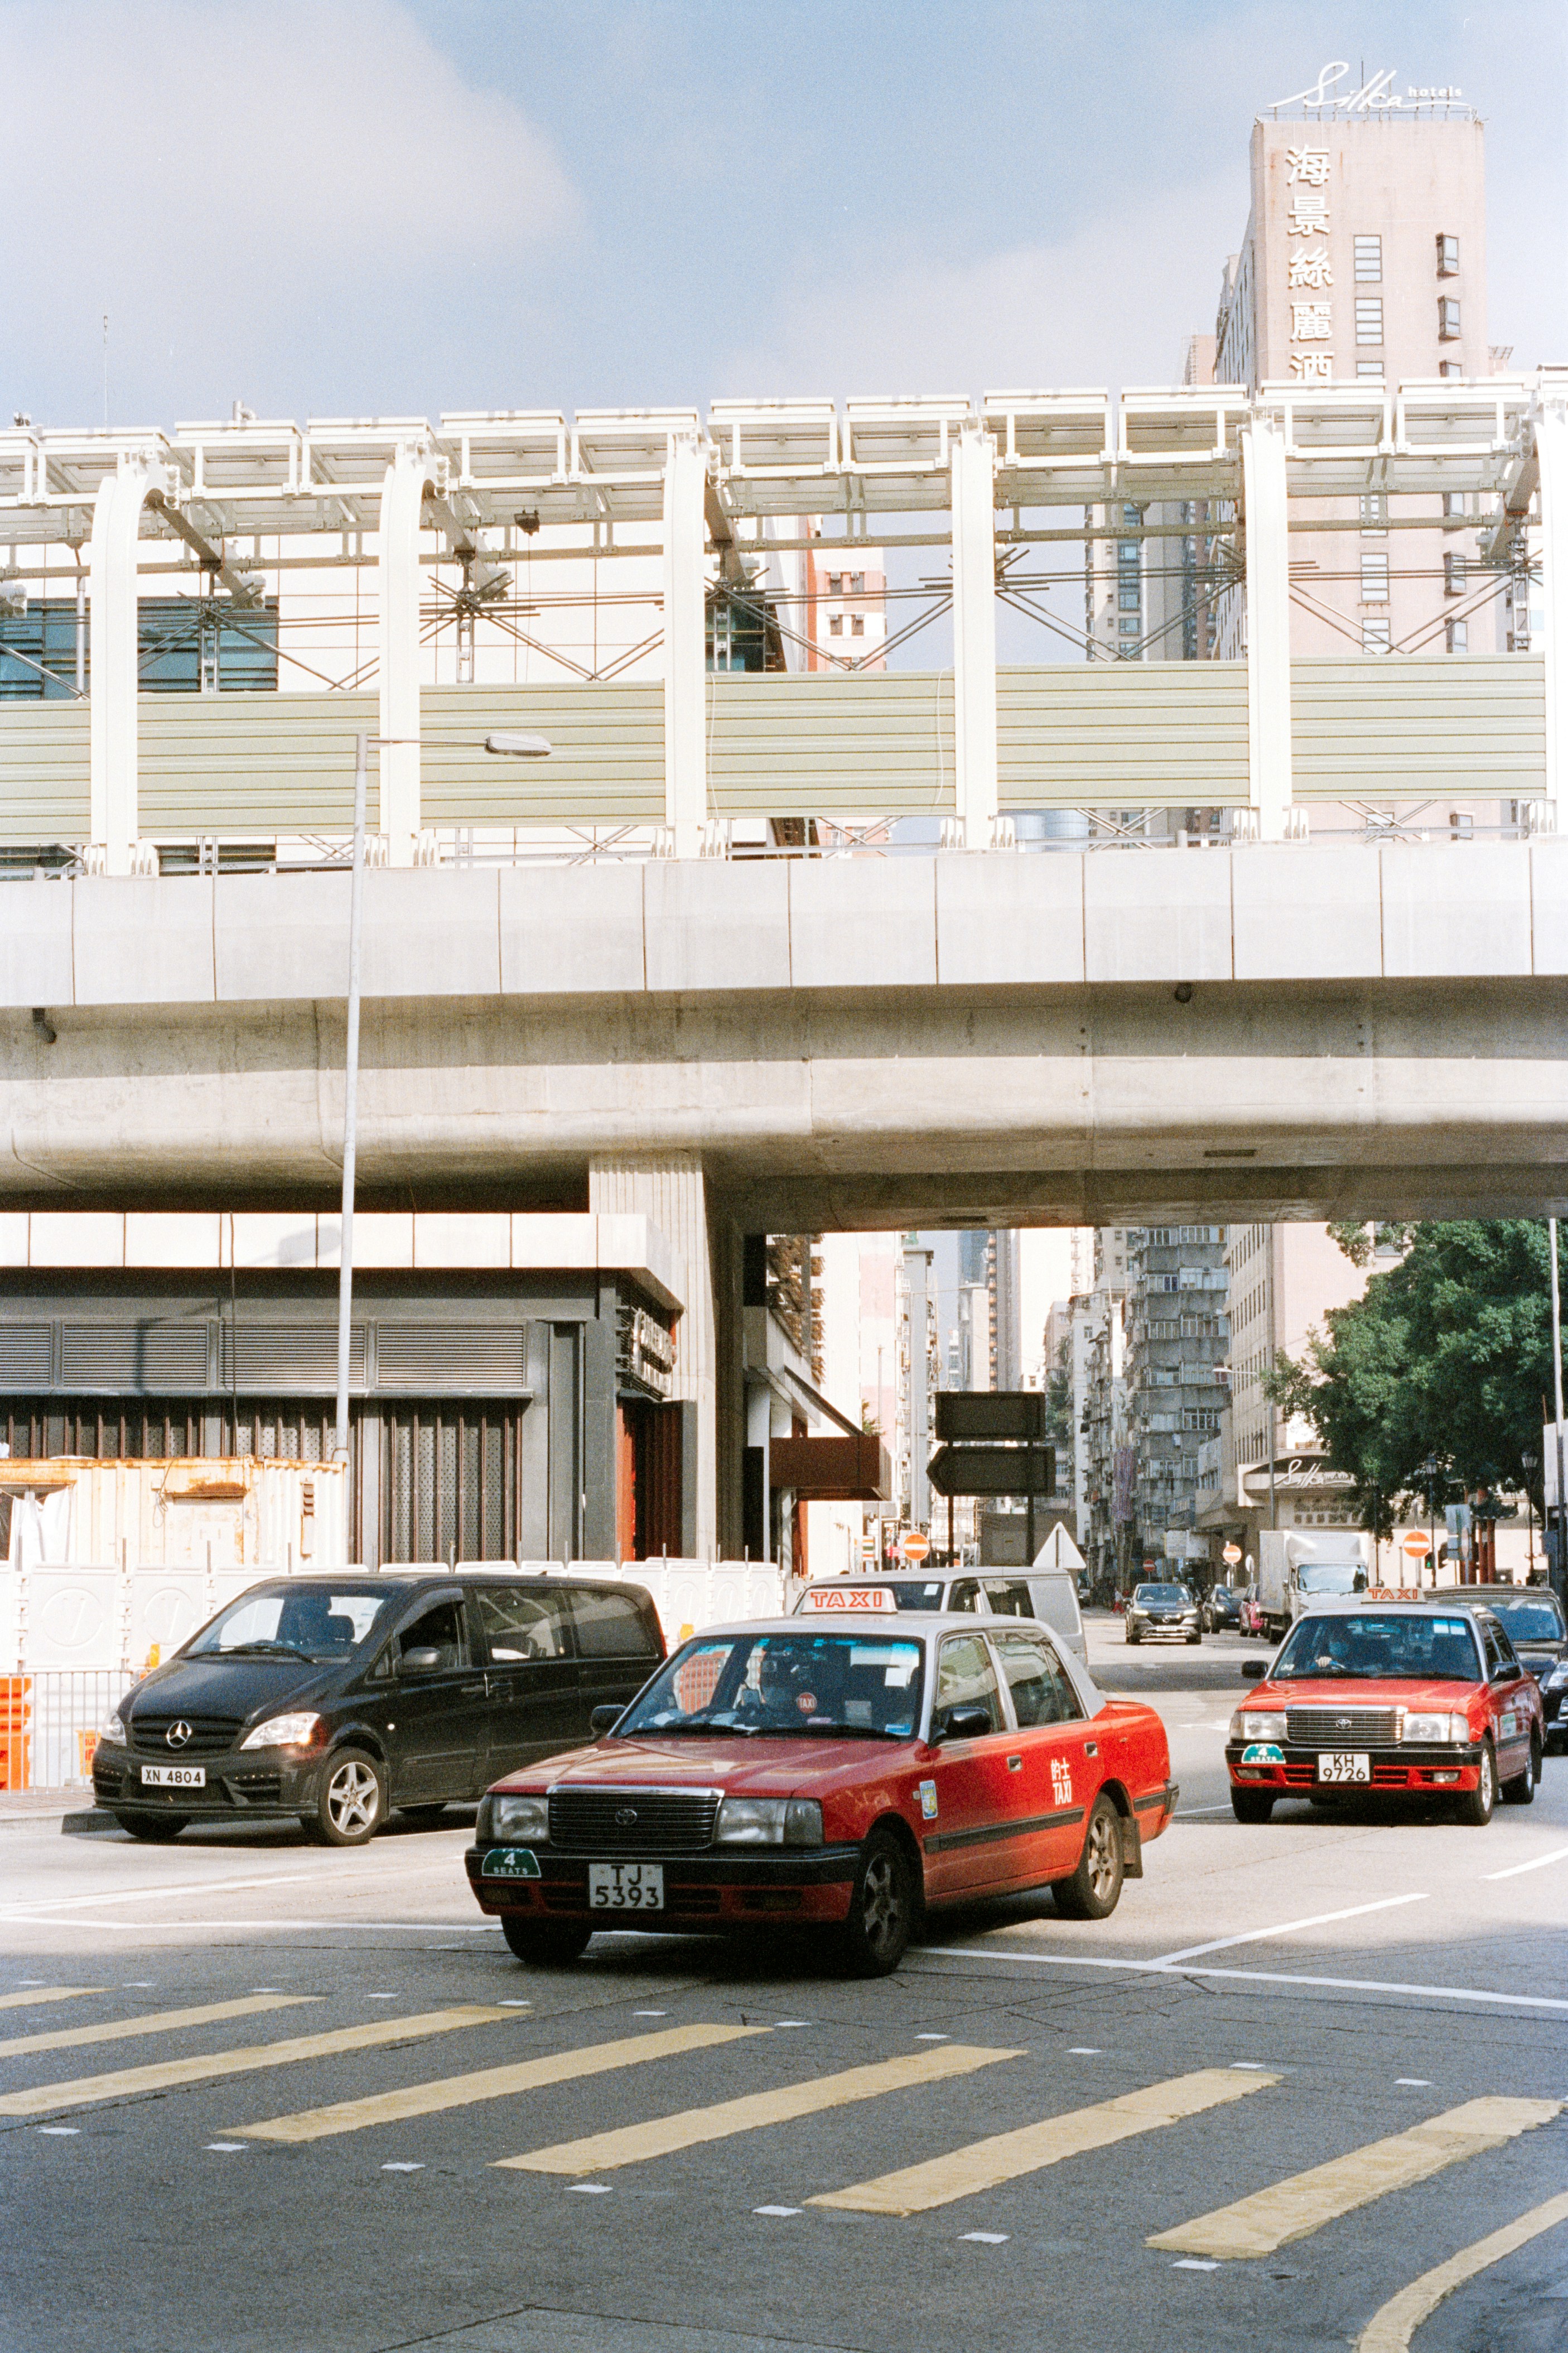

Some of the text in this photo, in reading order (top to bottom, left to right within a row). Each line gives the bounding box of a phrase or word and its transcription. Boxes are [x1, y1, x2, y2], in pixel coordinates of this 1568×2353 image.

[1266, 61, 1462, 112] Silka hotels
[1285, 145, 1335, 380] 海景絲麗酒
[1273, 1459, 1324, 1487] Silka
[810, 1591, 882, 1608] TAXI
[1368, 1589, 1418, 1599] TAXI
[799, 1697, 815, 1709] TAXI
[1258, 1747, 1267, 1757] 4
[1051, 1757, 1070, 1781] 的士
[1334, 1755, 1354, 1767] KH
[146, 1769, 201, 1784] XN 4804
[1323, 1768, 1366, 1780] 9726
[1053, 1780, 1072, 1805] TAXI
[504, 1852, 515, 1866] 4
[494, 1866, 528, 1875] SEATS
[611, 1865, 641, 1885] TJ
[595, 1885, 659, 1907] 5393
